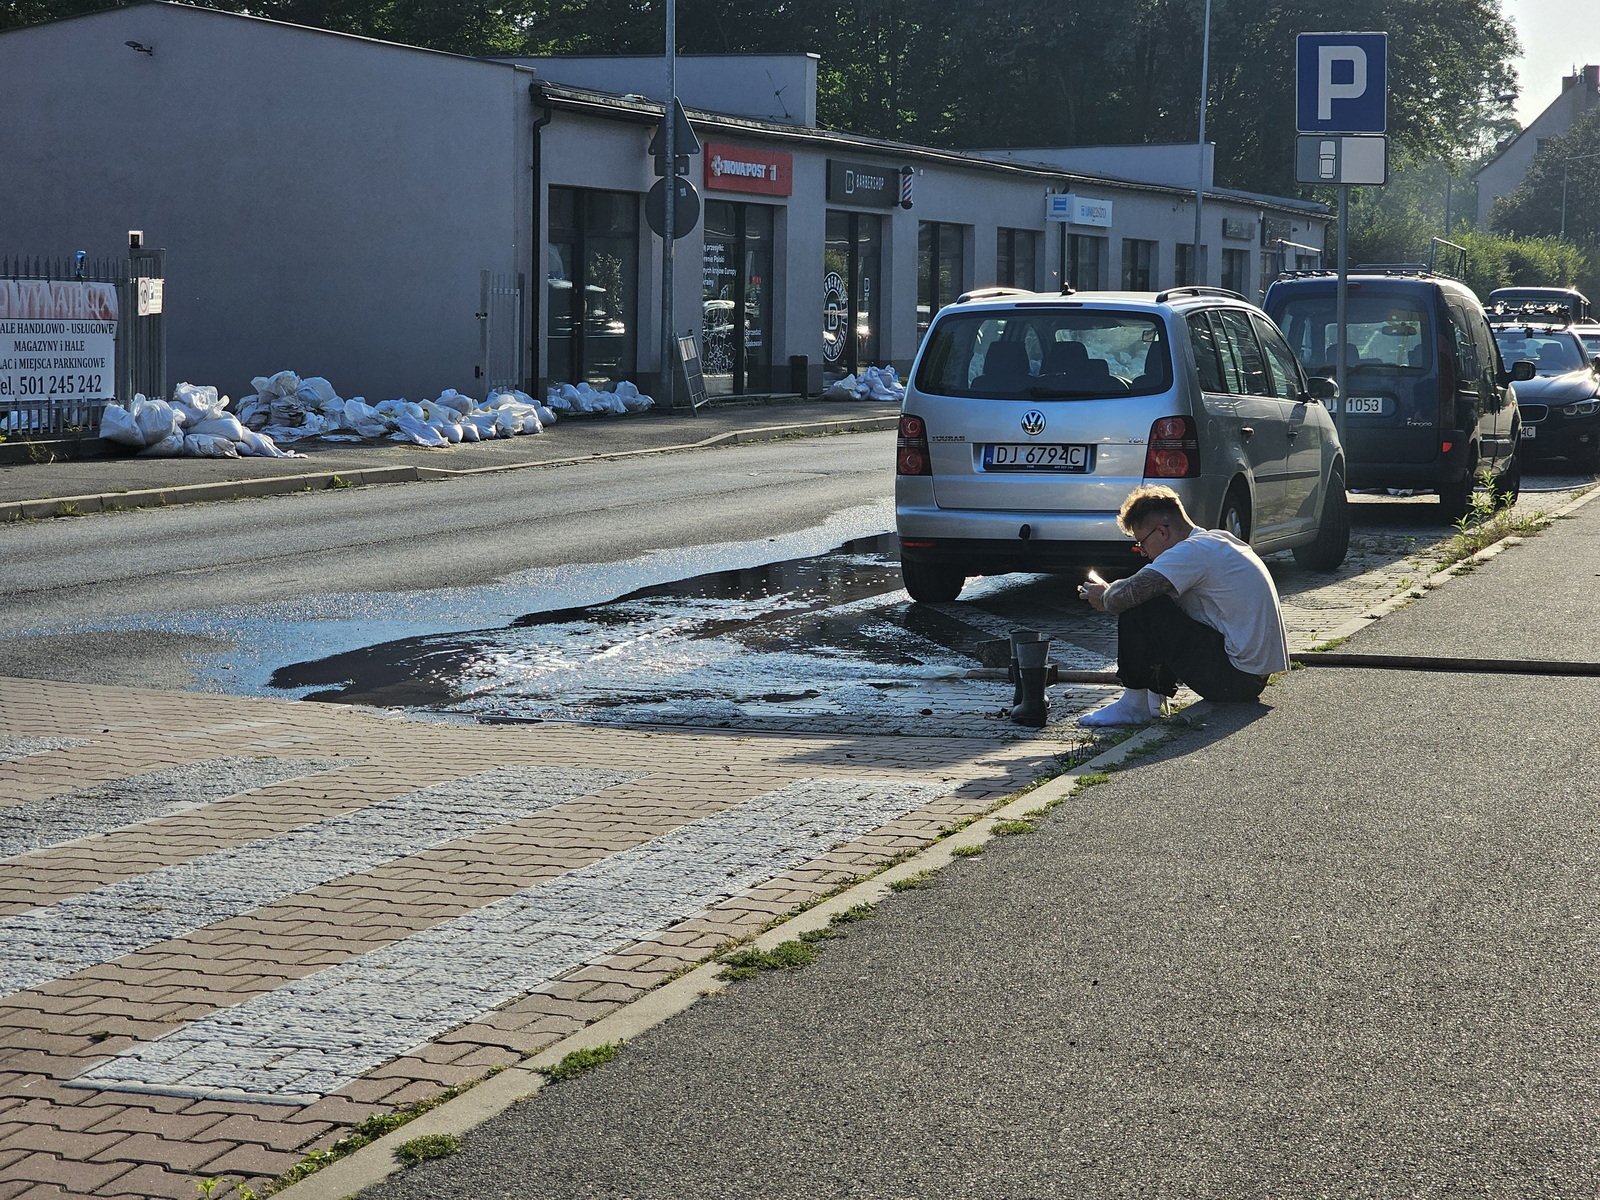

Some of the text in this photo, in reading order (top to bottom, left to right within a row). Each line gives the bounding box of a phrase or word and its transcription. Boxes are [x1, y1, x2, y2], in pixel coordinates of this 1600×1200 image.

[1318, 45, 1367, 120] P
[722, 160, 747, 176] NOVA
[747, 163, 767, 178] POST
[856, 174, 885, 191] BARBERSHOP
[17, 323, 65, 334] HANDLOWO
[71, 323, 115, 335] USŁUGOWE
[14, 340, 59, 352] MAGAZYNY
[64, 340, 85, 352] HALE
[19, 359, 52, 371] MIEJSCA
[53, 357, 106, 369] PARKINGOWE
[20, 375, 46, 395] 501
[49, 374, 74, 394] 245
[78, 374, 102, 393] 242
[1347, 399, 1380, 412] 1053
[1521, 426, 1534, 437] 4C
[996, 446, 1081, 465] DJ 6794C
